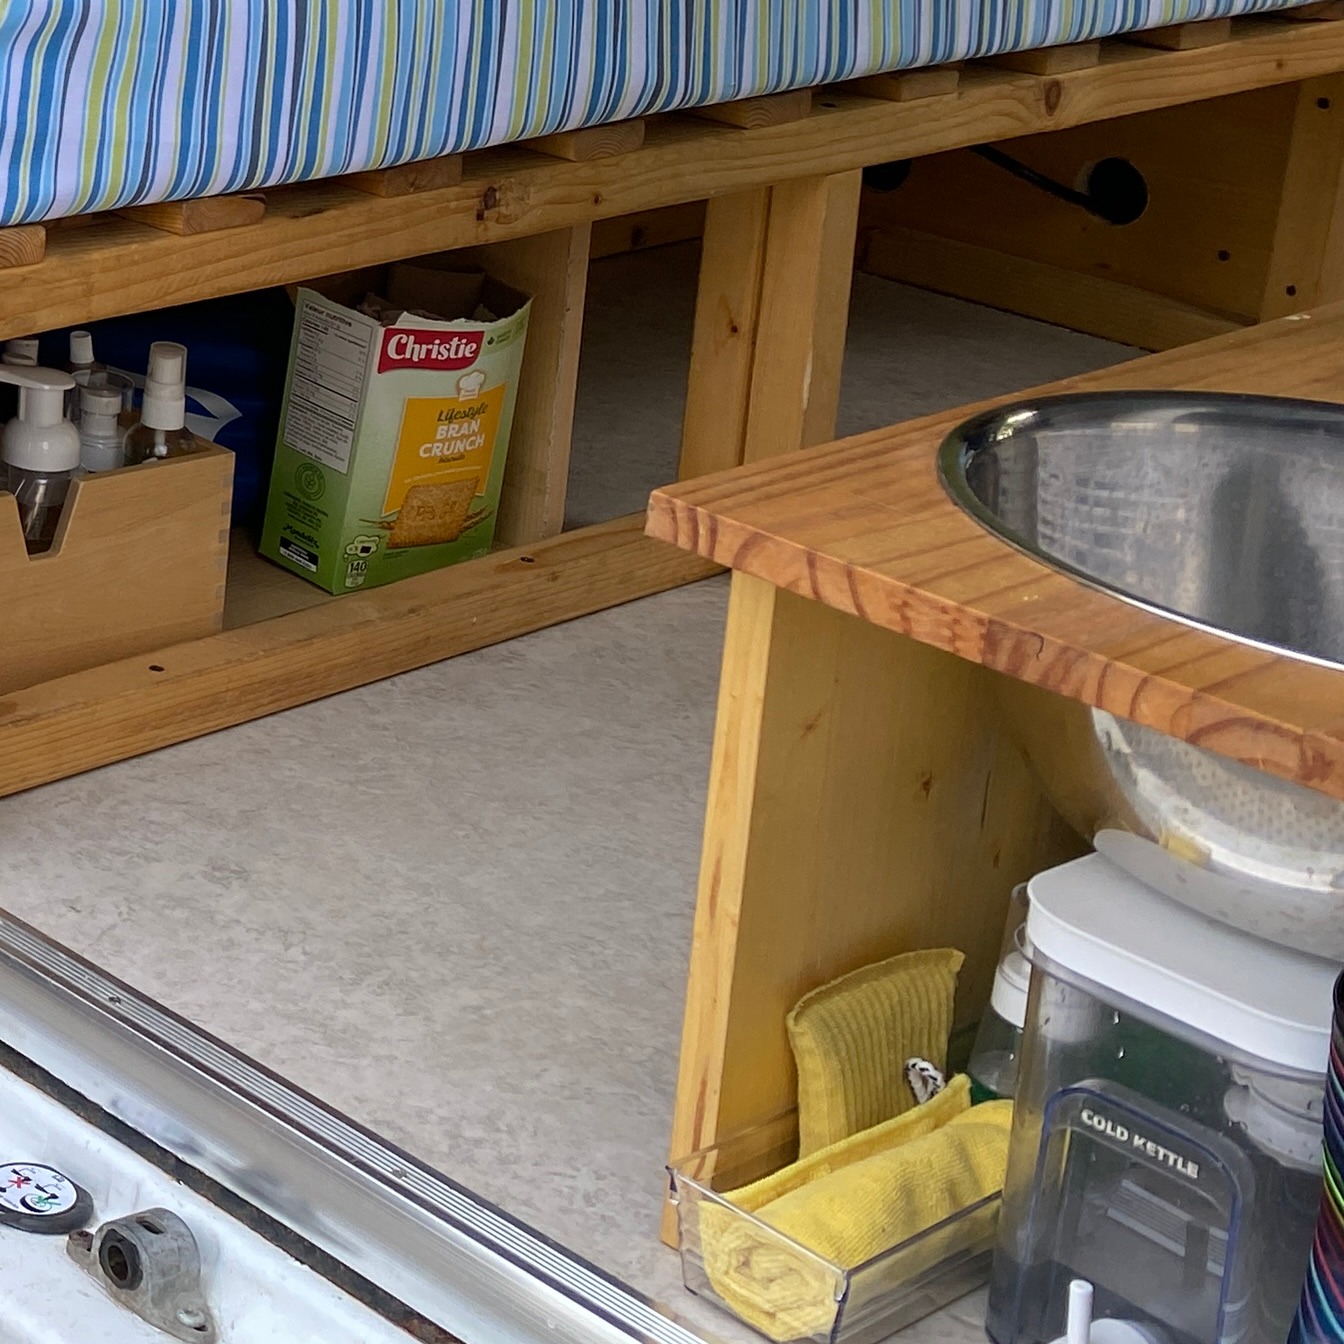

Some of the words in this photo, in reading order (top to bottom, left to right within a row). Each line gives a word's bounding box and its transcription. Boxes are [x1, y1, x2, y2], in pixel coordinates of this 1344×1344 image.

[387, 334, 477, 362] Christie
[437, 402, 489, 424] Lifestyle
[436, 419, 480, 439] BRAN
[419, 434, 485, 458] CRUNCH
[350, 560, 367, 573] 140
[1081, 1108, 1129, 1141] COLD
[1133, 1134, 1199, 1178] KETTLE
